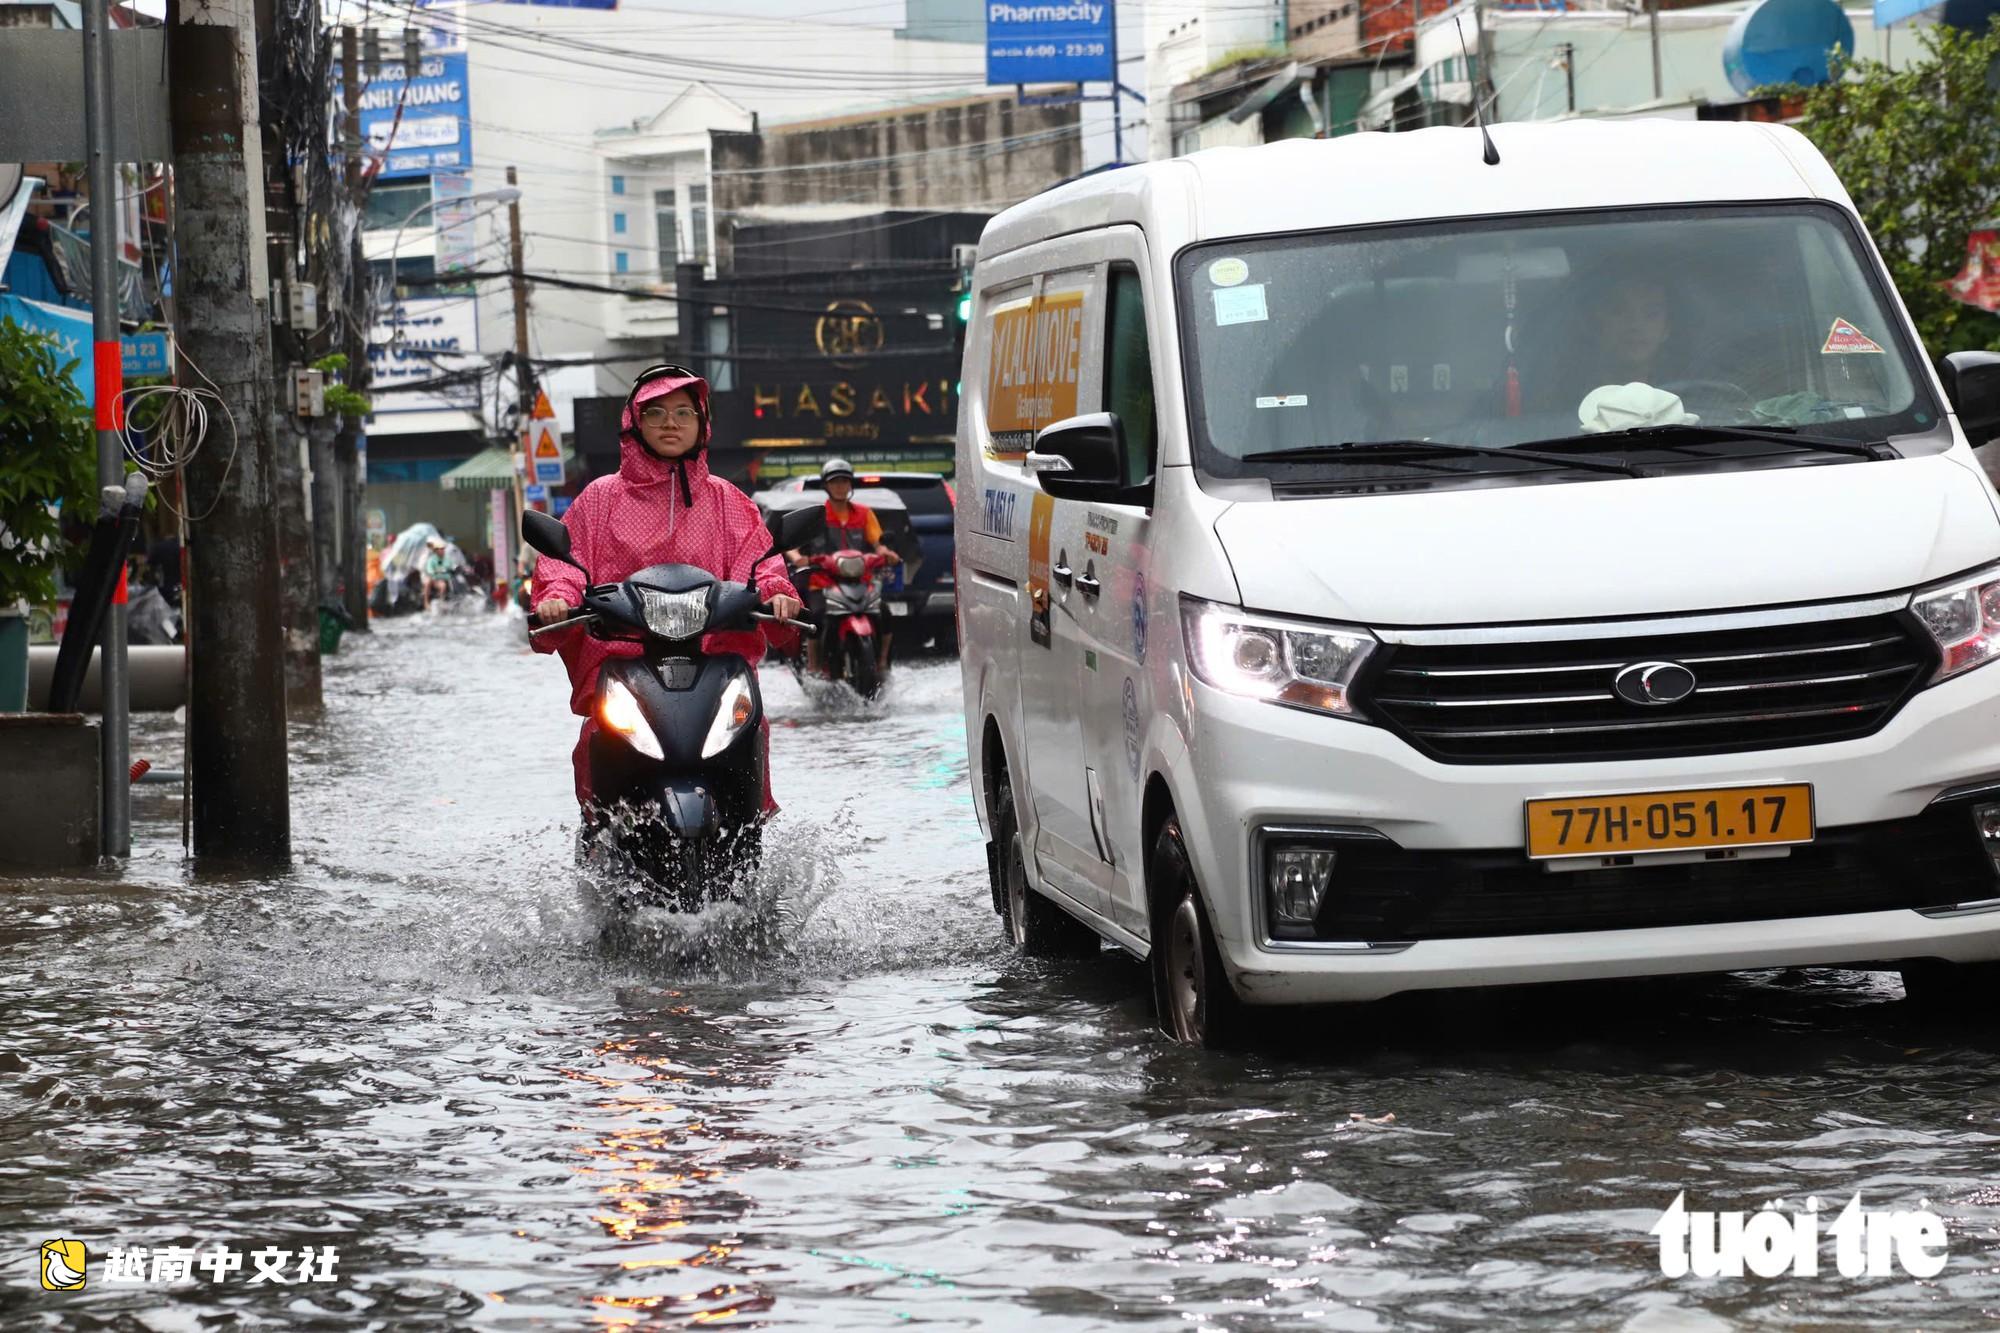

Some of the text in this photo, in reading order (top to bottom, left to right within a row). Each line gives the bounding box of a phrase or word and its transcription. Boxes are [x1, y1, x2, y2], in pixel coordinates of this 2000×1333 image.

[989, 3, 1103, 24] Pharmacity
[1025, 44, 1055, 57] 6:00
[1066, 43, 1104, 56] 23:30
[397, 82, 461, 107] QUANG
[754, 379, 949, 419] HASAKI
[824, 422, 880, 440] Beauty
[1551, 796, 1786, 845] 77H-051.17
